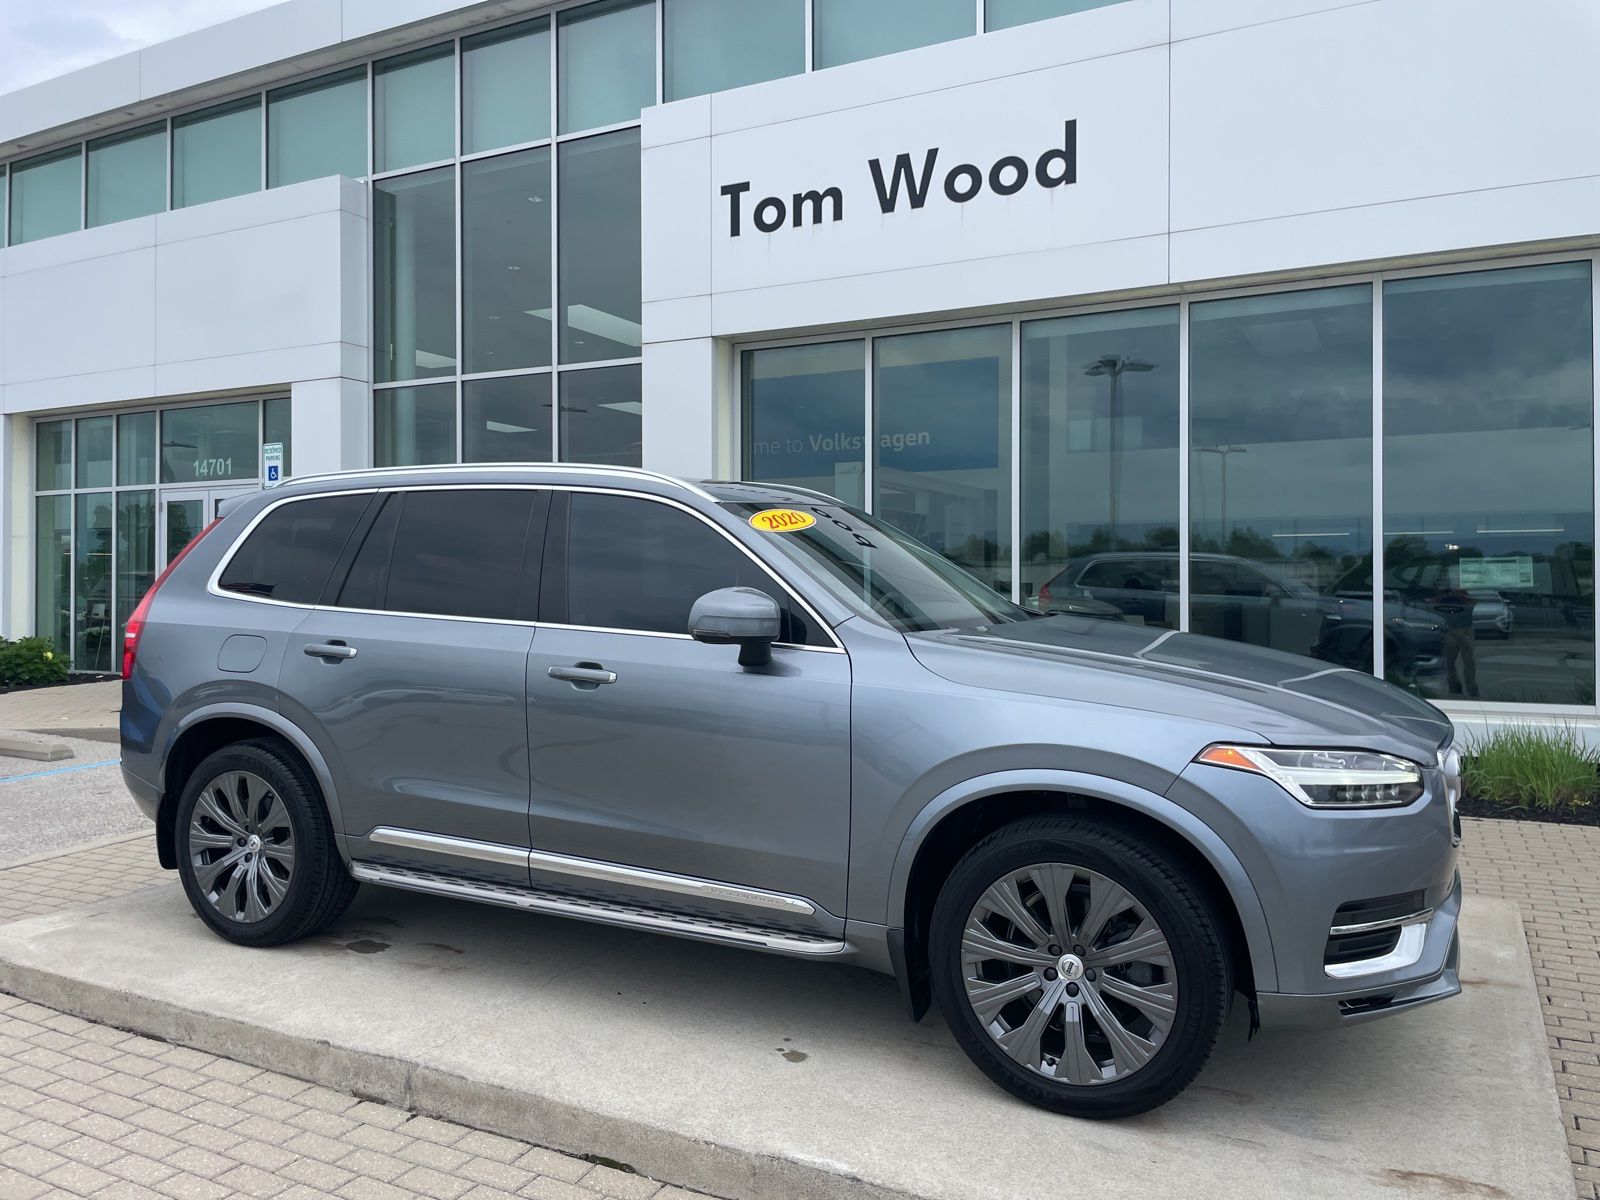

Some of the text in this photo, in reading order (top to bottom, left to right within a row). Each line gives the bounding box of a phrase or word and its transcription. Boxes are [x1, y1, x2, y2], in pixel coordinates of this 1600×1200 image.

[720, 118, 1077, 238] Tom Wood
[787, 439, 803, 454] to
[809, 431, 930, 452] Volksagen
[193, 457, 232, 477] 14701
[762, 511, 806, 529] 2020
